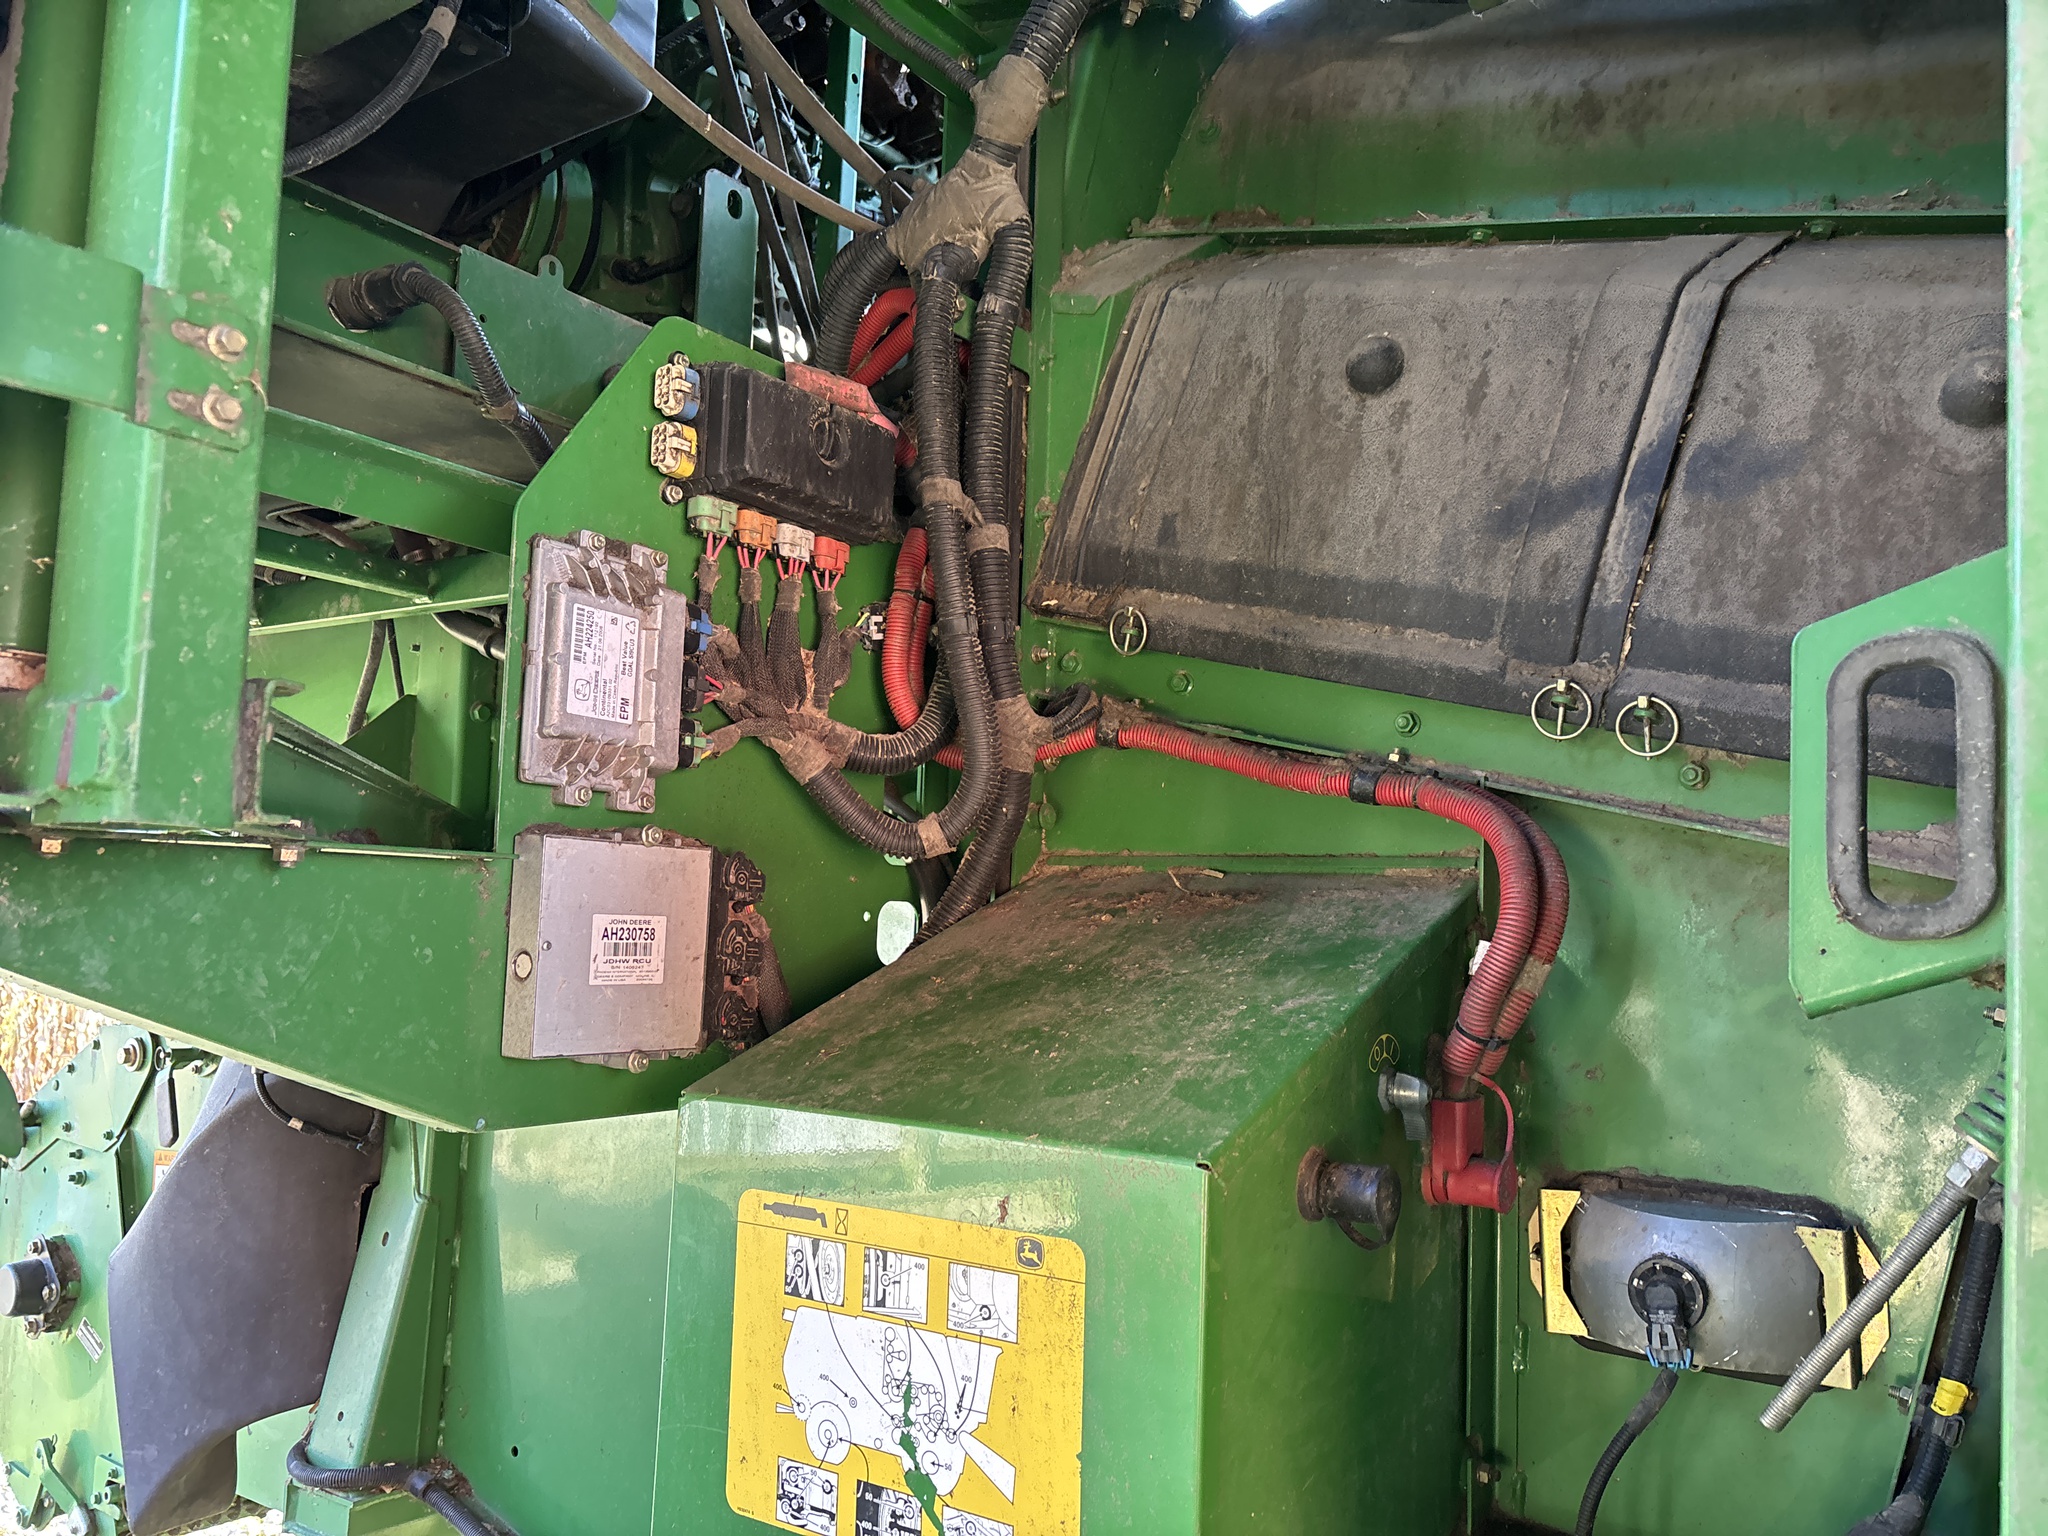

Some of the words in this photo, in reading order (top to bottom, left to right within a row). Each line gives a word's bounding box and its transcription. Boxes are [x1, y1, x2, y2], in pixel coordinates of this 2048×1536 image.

[585, 610, 594, 649] AH224250
[620, 698, 630, 720] EPM
[602, 927, 656, 941] AH230758
[914, 1262, 925, 1270] 400
[953, 1321, 964, 1329] 400
[961, 1375, 972, 1383] 400
[772, 1383, 782, 1391] 400
[820, 1524, 830, 1532] 400
[862, 1520, 872, 1530] 400
